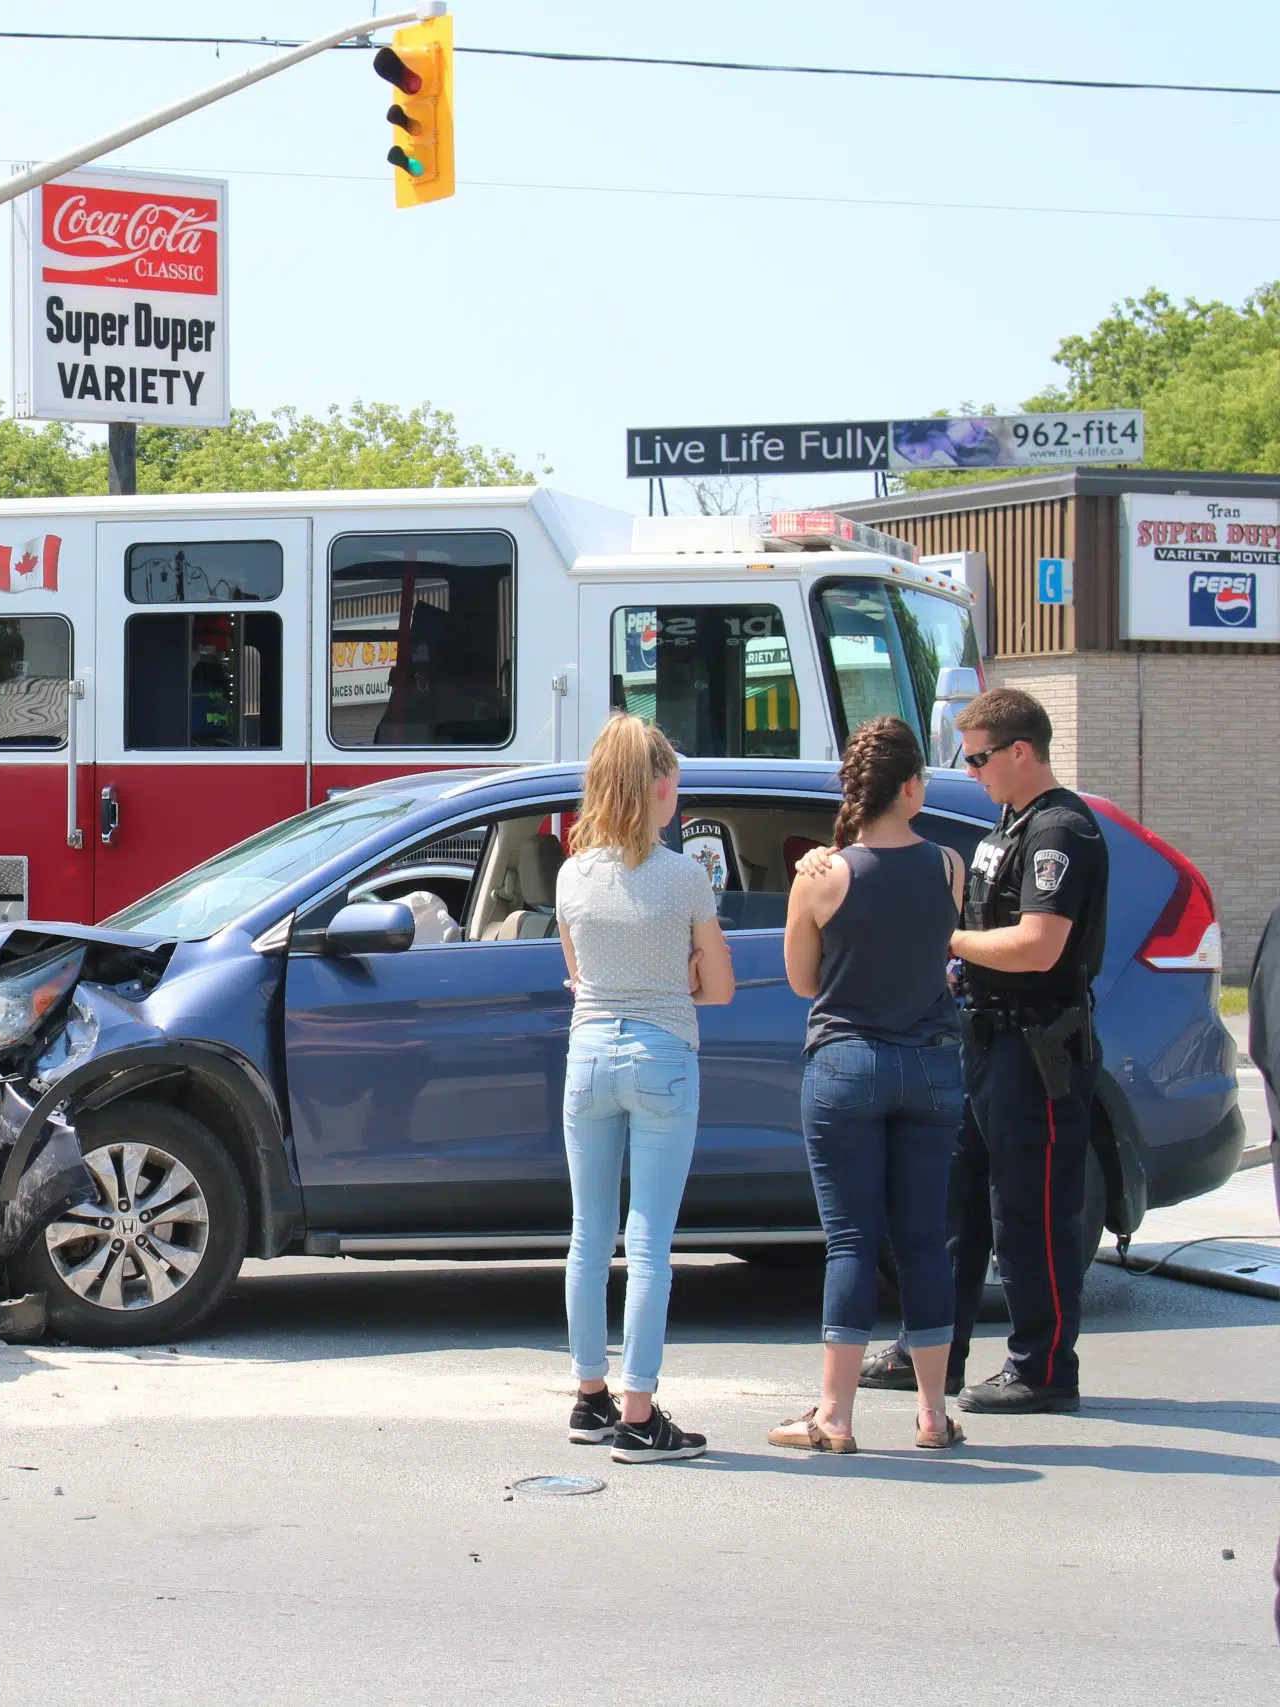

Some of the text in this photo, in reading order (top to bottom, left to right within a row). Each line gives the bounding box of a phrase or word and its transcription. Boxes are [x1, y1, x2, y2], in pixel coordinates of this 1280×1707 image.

[134, 257, 204, 282] CLASSIC
[45, 295, 215, 362] Super Duper
[57, 362, 205, 406] VARIETY
[1013, 418, 1138, 448] 962-fit4
[634, 435, 705, 465] Live
[720, 431, 785, 463] Life
[1029, 446, 1124, 458] www.fit-4-life.ca
[1207, 503, 1241, 519] Tran
[1137, 520, 1217, 547] SUPER
[1158, 549, 1220, 561] VARIETY
[628, 611, 657, 633] PEPS
[354, 684, 364, 696] ON
